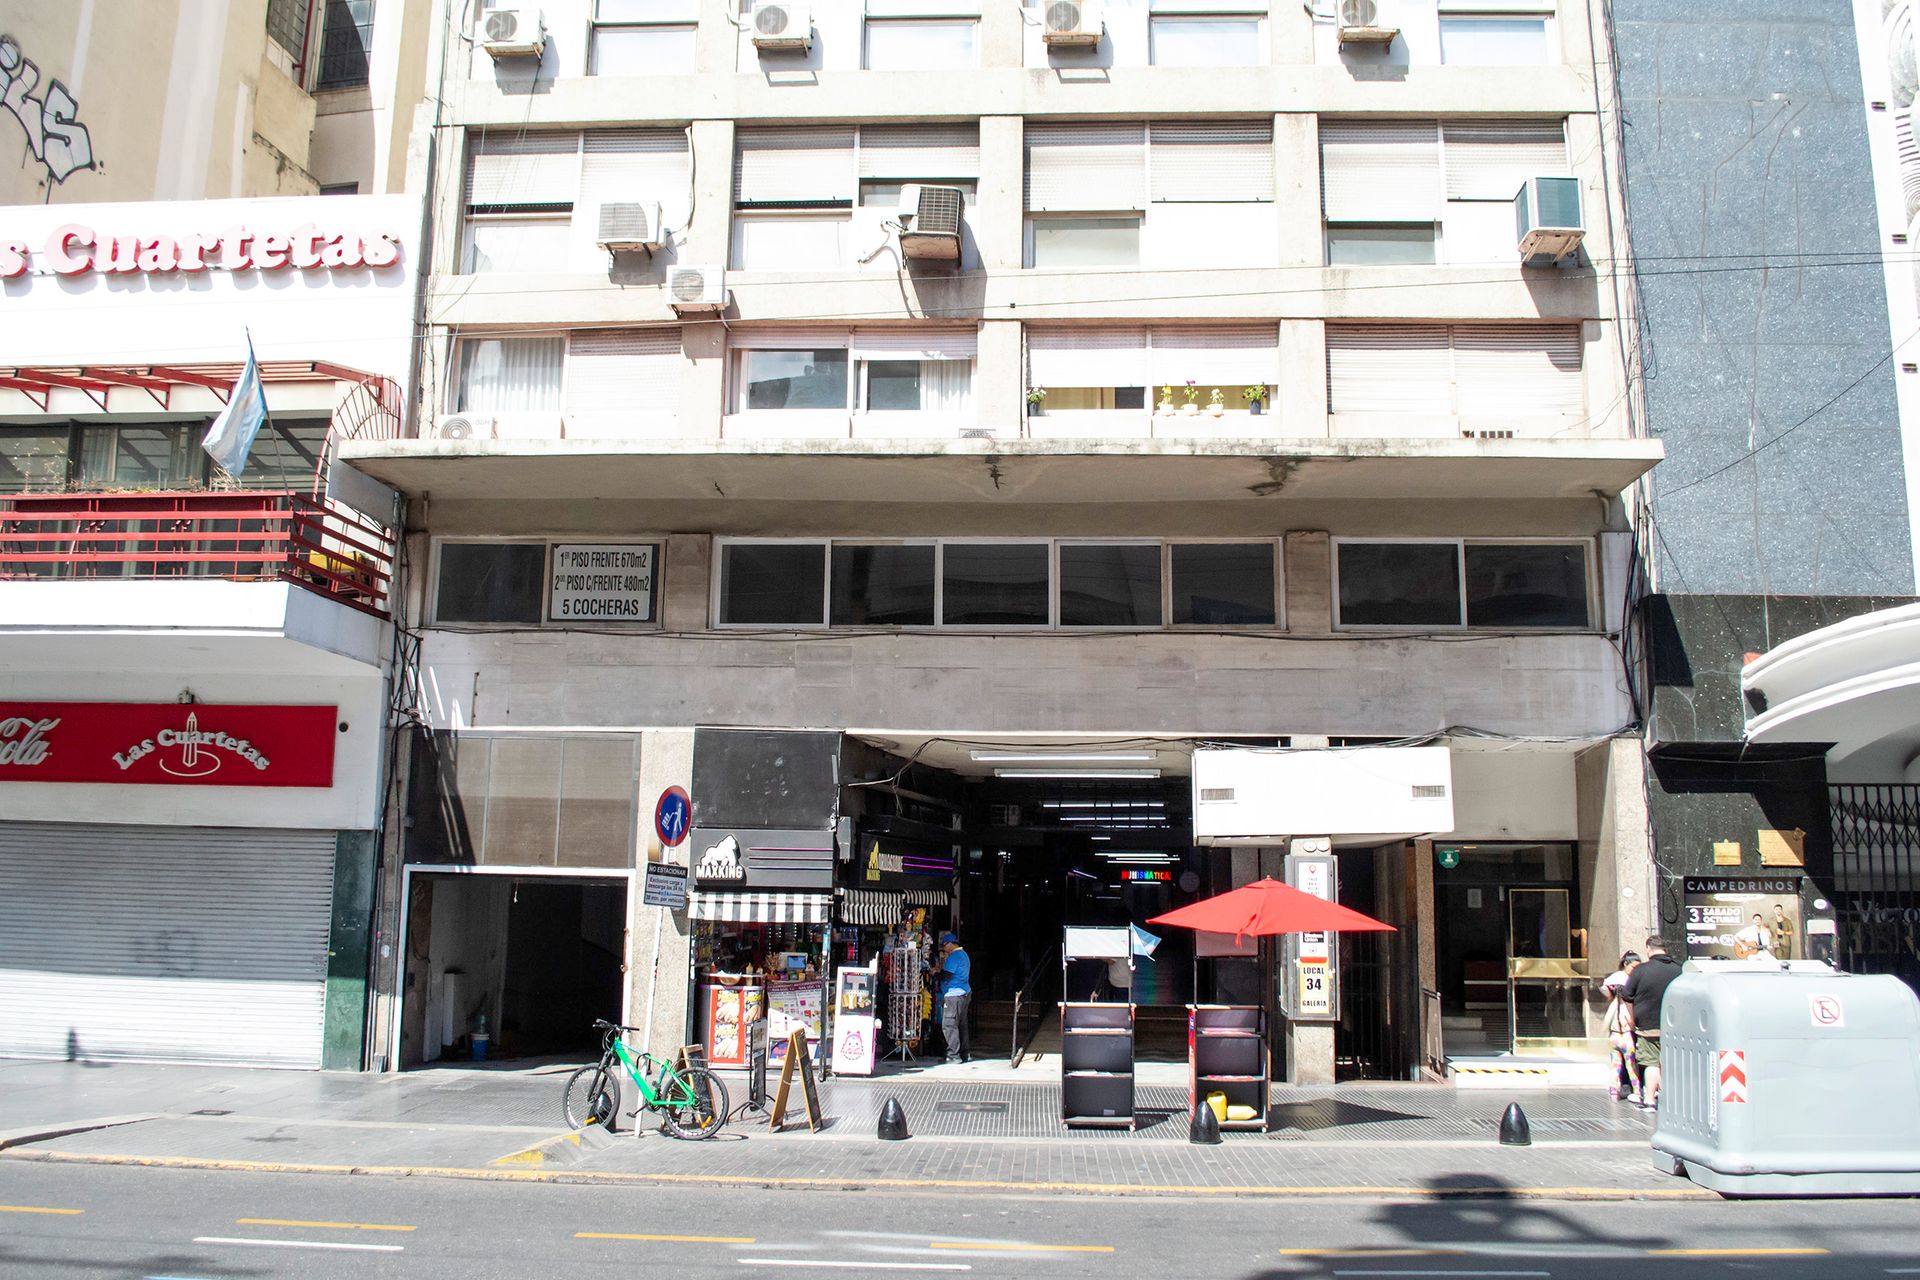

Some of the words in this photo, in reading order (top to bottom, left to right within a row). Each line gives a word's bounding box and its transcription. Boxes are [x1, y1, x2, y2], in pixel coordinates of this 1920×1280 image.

[45, 223, 400, 276] Cuartetas
[571, 552, 589, 568] PISO
[591, 552, 619, 568] FRENTE
[621, 552, 647, 568] 670m2
[566, 575, 585, 591] PISO
[624, 576, 649, 591] 480m2
[562, 599, 570, 615] 5
[573, 599, 639, 615] COCHERAS
[112, 738, 156, 771] Las
[157, 728, 271, 771] Cuartetas
[657, 867, 686, 876] ESTACIONAR
[695, 865, 743, 879] MAXKING
[1687, 881, 1793, 891] CAMPEDRINOS
[1689, 908, 1700, 922] 3
[1303, 967, 1324, 975] LOCAL
[1306, 978, 1322, 990] 34
